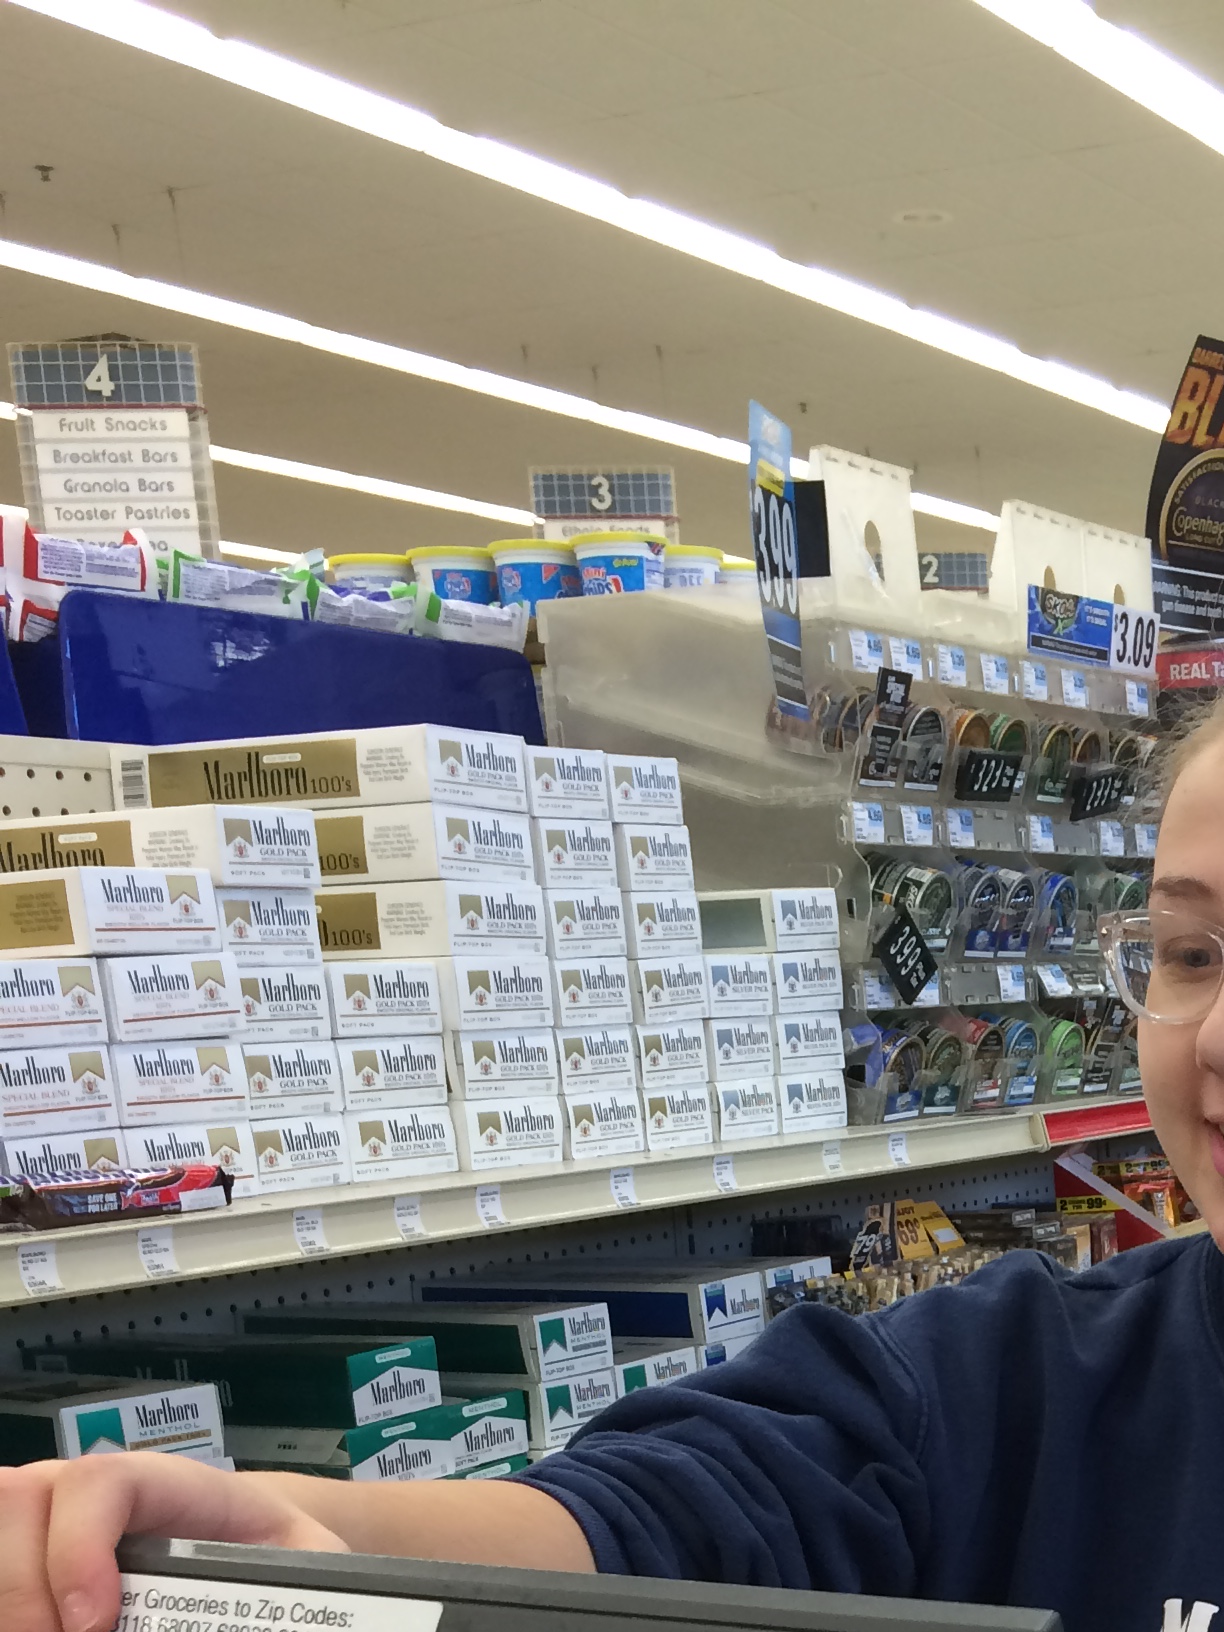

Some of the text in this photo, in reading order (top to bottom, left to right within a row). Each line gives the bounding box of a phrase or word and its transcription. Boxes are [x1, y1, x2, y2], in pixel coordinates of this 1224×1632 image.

[84, 353, 115, 397] 4
[59, 416, 168, 432] Fruit Snacks
[53, 448, 178, 464] Breakfast Bars
[63, 478, 175, 493] Granola Bars
[590, 475, 613, 510] 3
[54, 506, 191, 521] Toaster Pastries
[922, 555, 939, 583] 2
[1114, 612, 1156, 669] $3.09
[1170, 663, 1211, 681] REAL
[203, 752, 352, 800] Marlboro 100's
[100, 874, 165, 904] Marlboro
[657, 898, 696, 922] Marlboro
[127, 964, 190, 994] Marlboro
[801, 958, 836, 982] Marlboro
[262, 968, 321, 1002] Marlboro
[803, 1020, 838, 1045] Marlboro
[133, 1049, 195, 1079] Marlboro
[272, 1040, 332, 1079] Marlboro
[738, 1084, 774, 1106] Marlboro
[805, 1079, 840, 1102] Marlboro
[144, 1133, 206, 1163] Marlboro
[283, 1119, 341, 1152] Marlboro
[730, 1289, 760, 1315] Marlboro
[569, 1312, 606, 1337] Marlboro
[653, 1357, 688, 1380] Marlboro
[371, 1371, 426, 1406] Marlboro
[134, 1397, 200, 1428] Marlboro
[139, 1423, 200, 1437] MENTHOL
[377, 1440, 432, 1478] Marlboro
[144, 1589, 230, 1617] Groceries
[233, 1598, 252, 1618] to
[256, 1600, 286, 1624] Zip
[290, 1603, 355, 1629] Codes:
